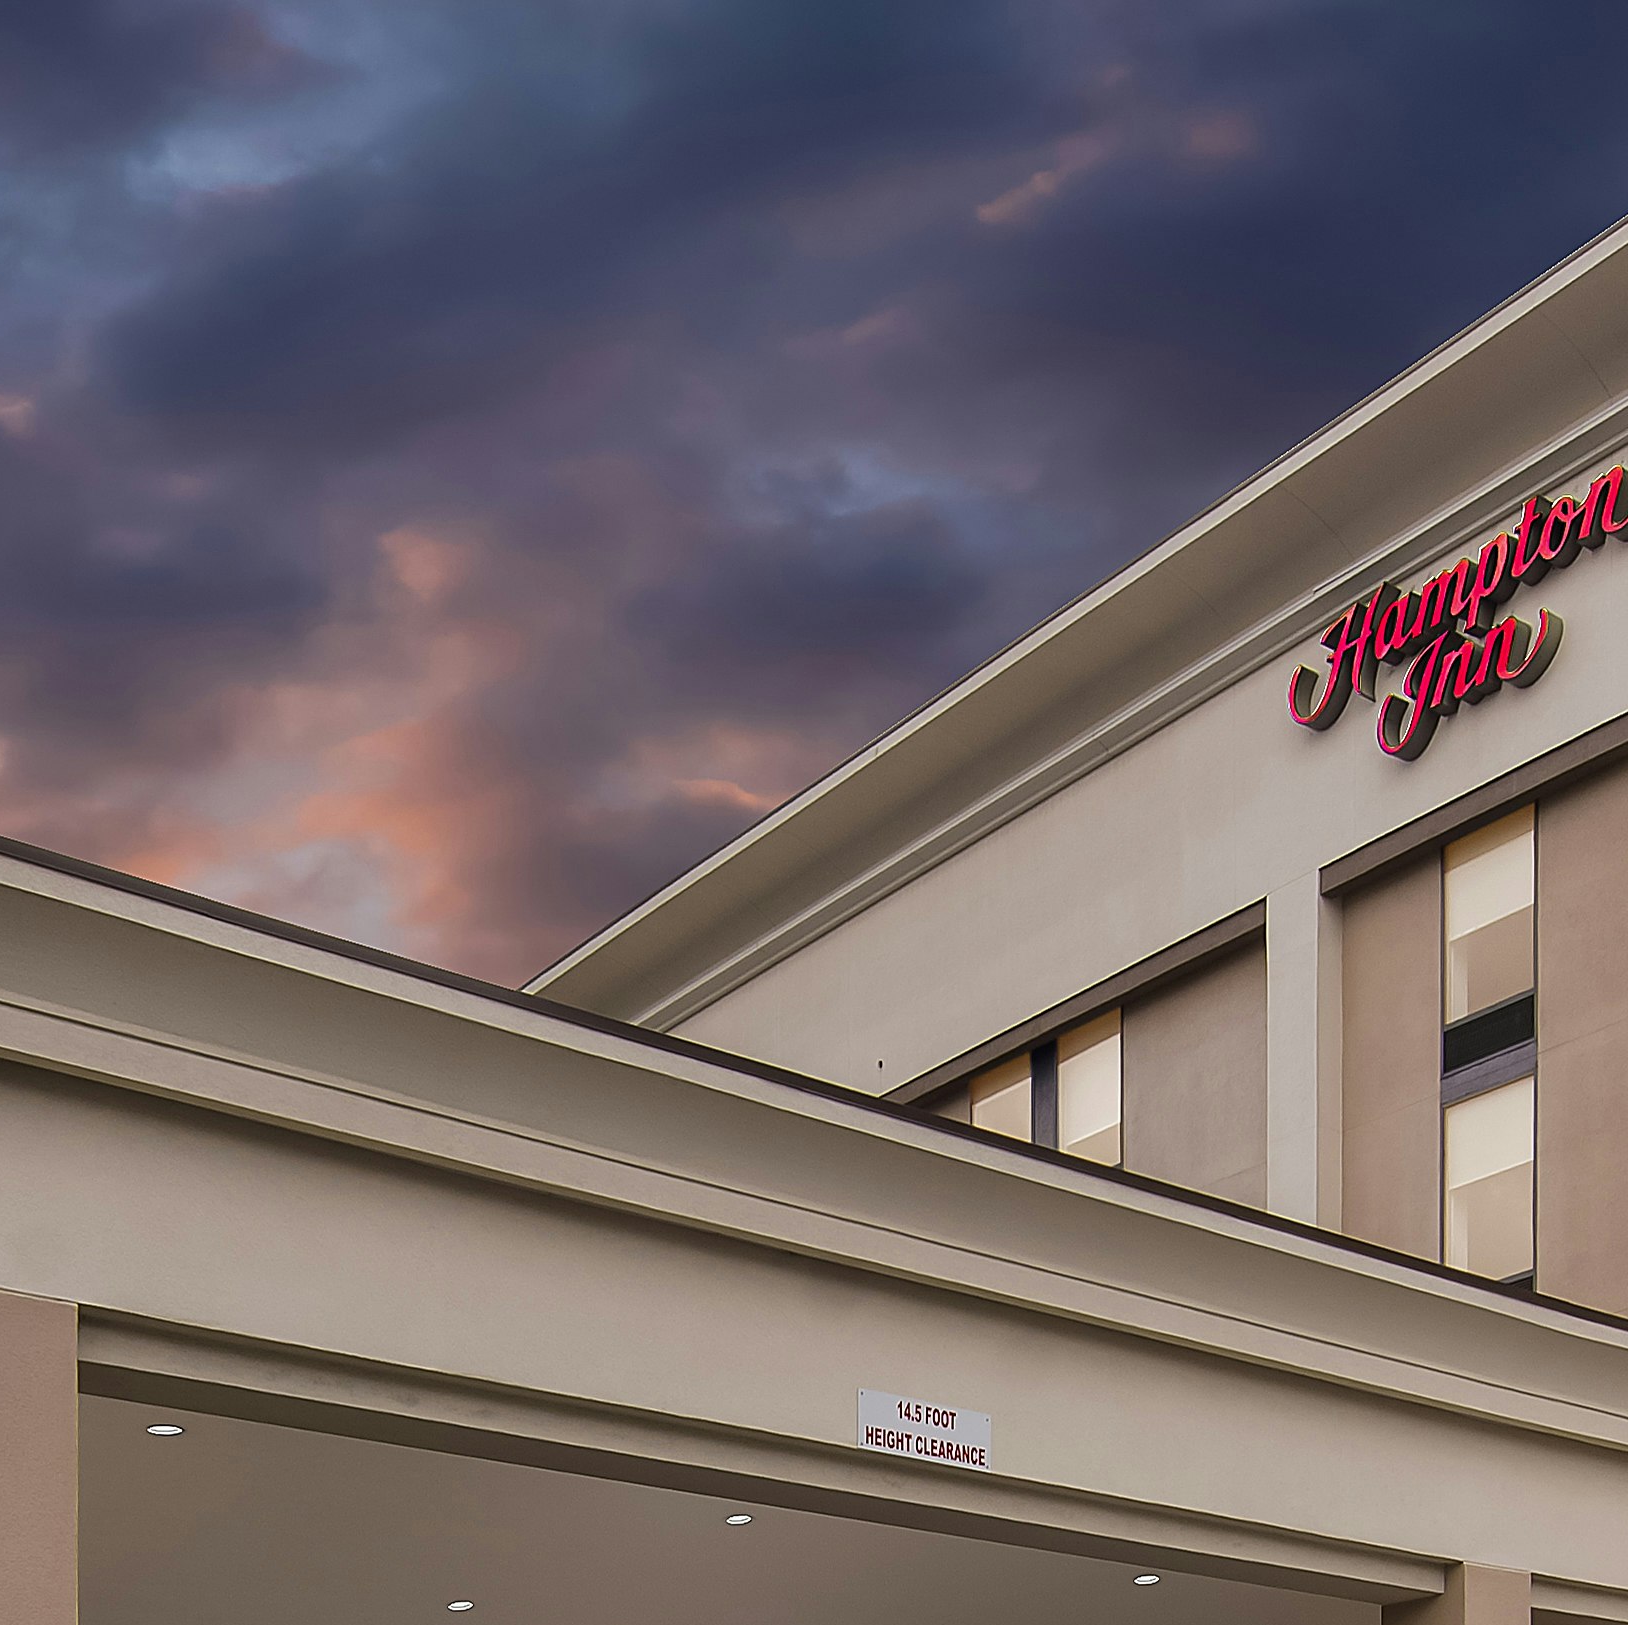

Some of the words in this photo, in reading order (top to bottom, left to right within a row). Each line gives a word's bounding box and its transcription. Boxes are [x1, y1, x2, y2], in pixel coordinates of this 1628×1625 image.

[1376, 608, 1563, 761] Inn
[897, 1400, 922, 1423] 14.5
[925, 1406, 957, 1430] FOOT
[865, 1425, 913, 1452] HEIGHT
[915, 1436, 986, 1466] CLEARANCE
